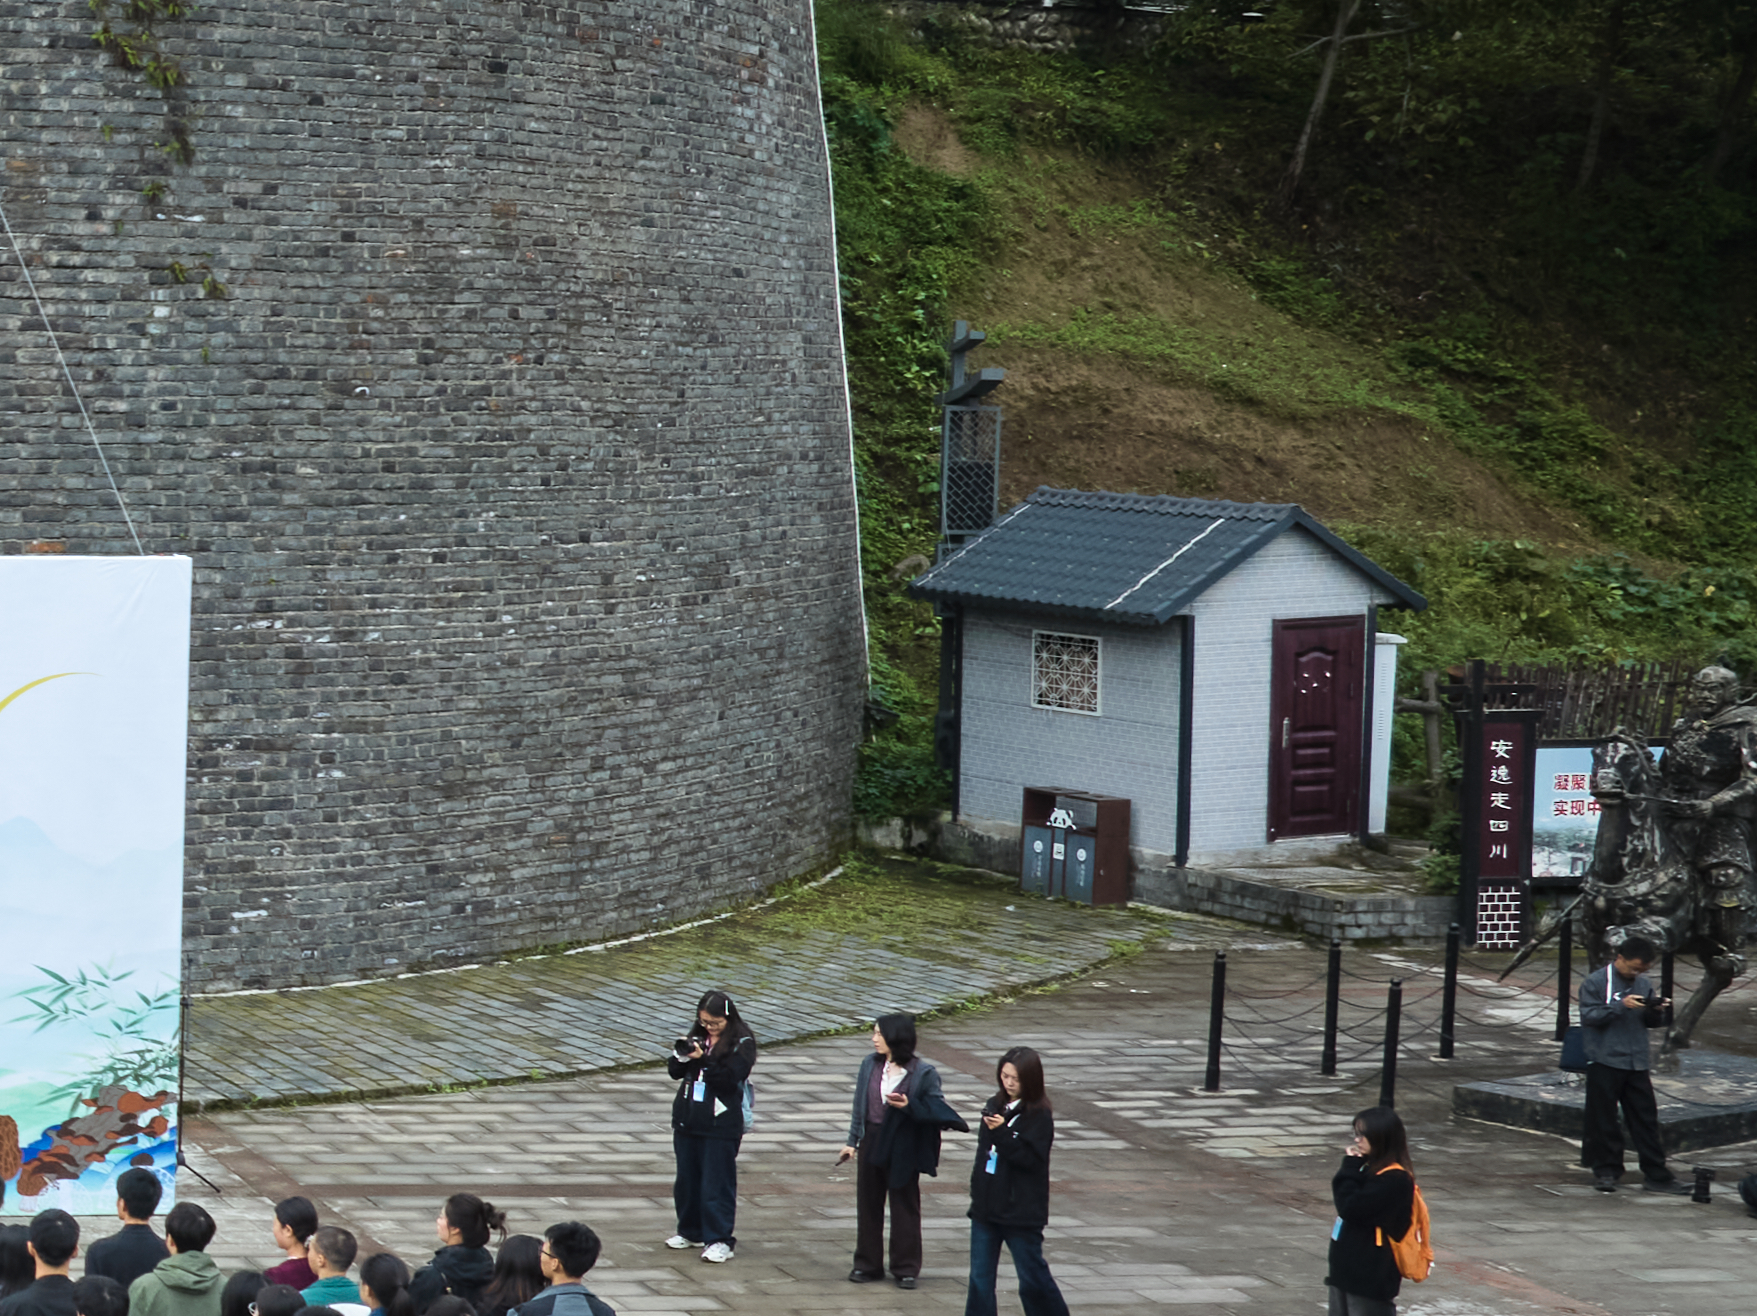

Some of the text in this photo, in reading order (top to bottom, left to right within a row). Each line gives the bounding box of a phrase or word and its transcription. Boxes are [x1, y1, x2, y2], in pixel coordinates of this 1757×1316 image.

[1489, 739, 1513, 859] 安逸走四川
[1554, 774, 1592, 790] 凝聚
